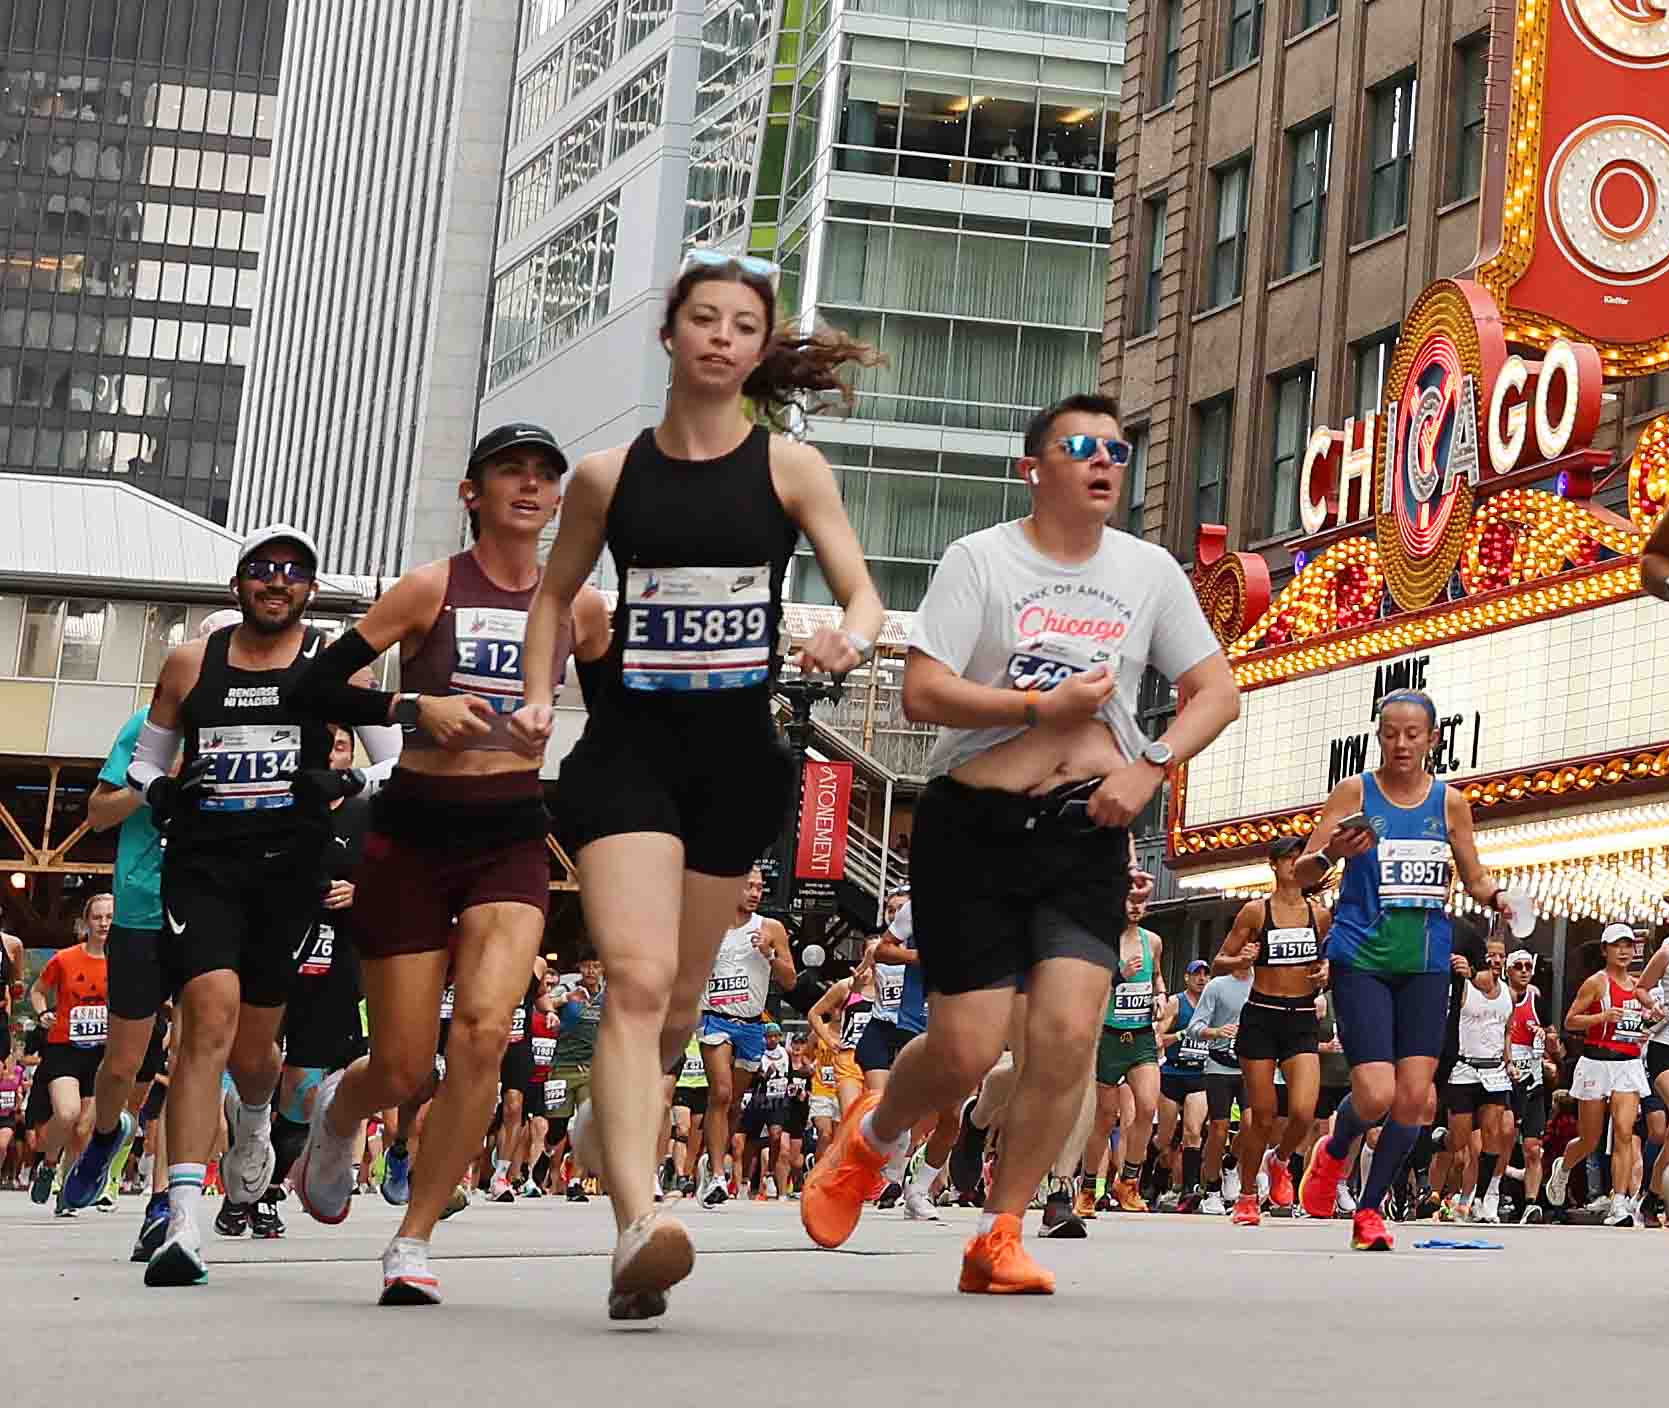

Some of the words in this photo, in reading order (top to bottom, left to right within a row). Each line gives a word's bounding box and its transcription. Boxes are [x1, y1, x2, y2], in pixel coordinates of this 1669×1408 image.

[1300, 338, 1579, 535] CHICAGO
[1054, 584, 1073, 595] OF
[1078, 585, 1133, 620] AMERICA
[628, 610, 649, 643] E
[663, 608, 768, 643] 15839
[1018, 605, 1127, 639] Chicago
[459, 642, 477, 672] E
[487, 644, 519, 675] 12
[237, 696, 280, 709] MADRES
[227, 752, 299, 782] 7134
[1327, 732, 1369, 795] NOV
[812, 765, 837, 876] ATONEMENT
[1380, 860, 1396, 884] E
[1400, 859, 1445, 884] 8951
[1269, 943, 1278, 957] E
[1280, 942, 1318, 957] 15105
[709, 981, 718, 992] D
[719, 976, 750, 992] 21560
[1115, 996, 1124, 1008] E
[72, 1024, 79, 1035] E
